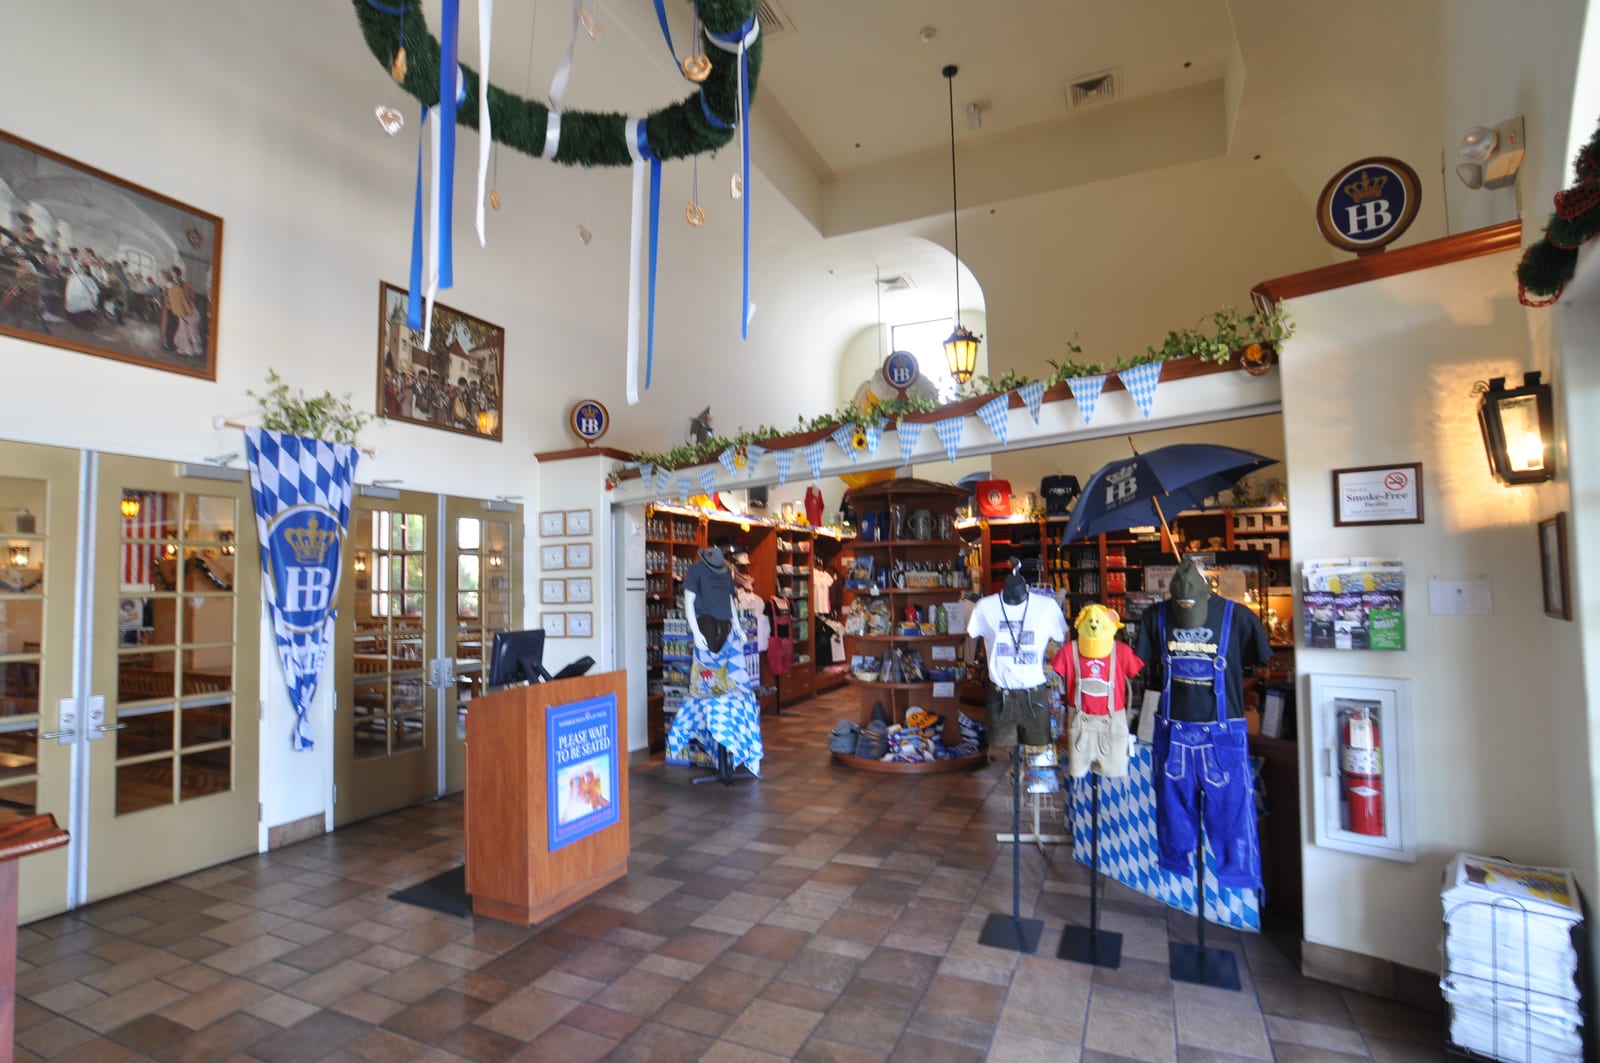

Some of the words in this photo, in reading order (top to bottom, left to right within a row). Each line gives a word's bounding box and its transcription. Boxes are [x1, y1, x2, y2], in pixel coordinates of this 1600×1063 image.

[1345, 199, 1392, 235] HB
[893, 367, 910, 382] HB
[581, 418, 599, 433] HB
[1105, 477, 1138, 505] HB
[283, 565, 331, 613] HB
[556, 749, 570, 765] TO
[570, 744, 581, 760] BE
[581, 736, 610, 756] SEATED
[558, 729, 588, 750] PLEASE
[588, 723, 608, 740] WAIT
